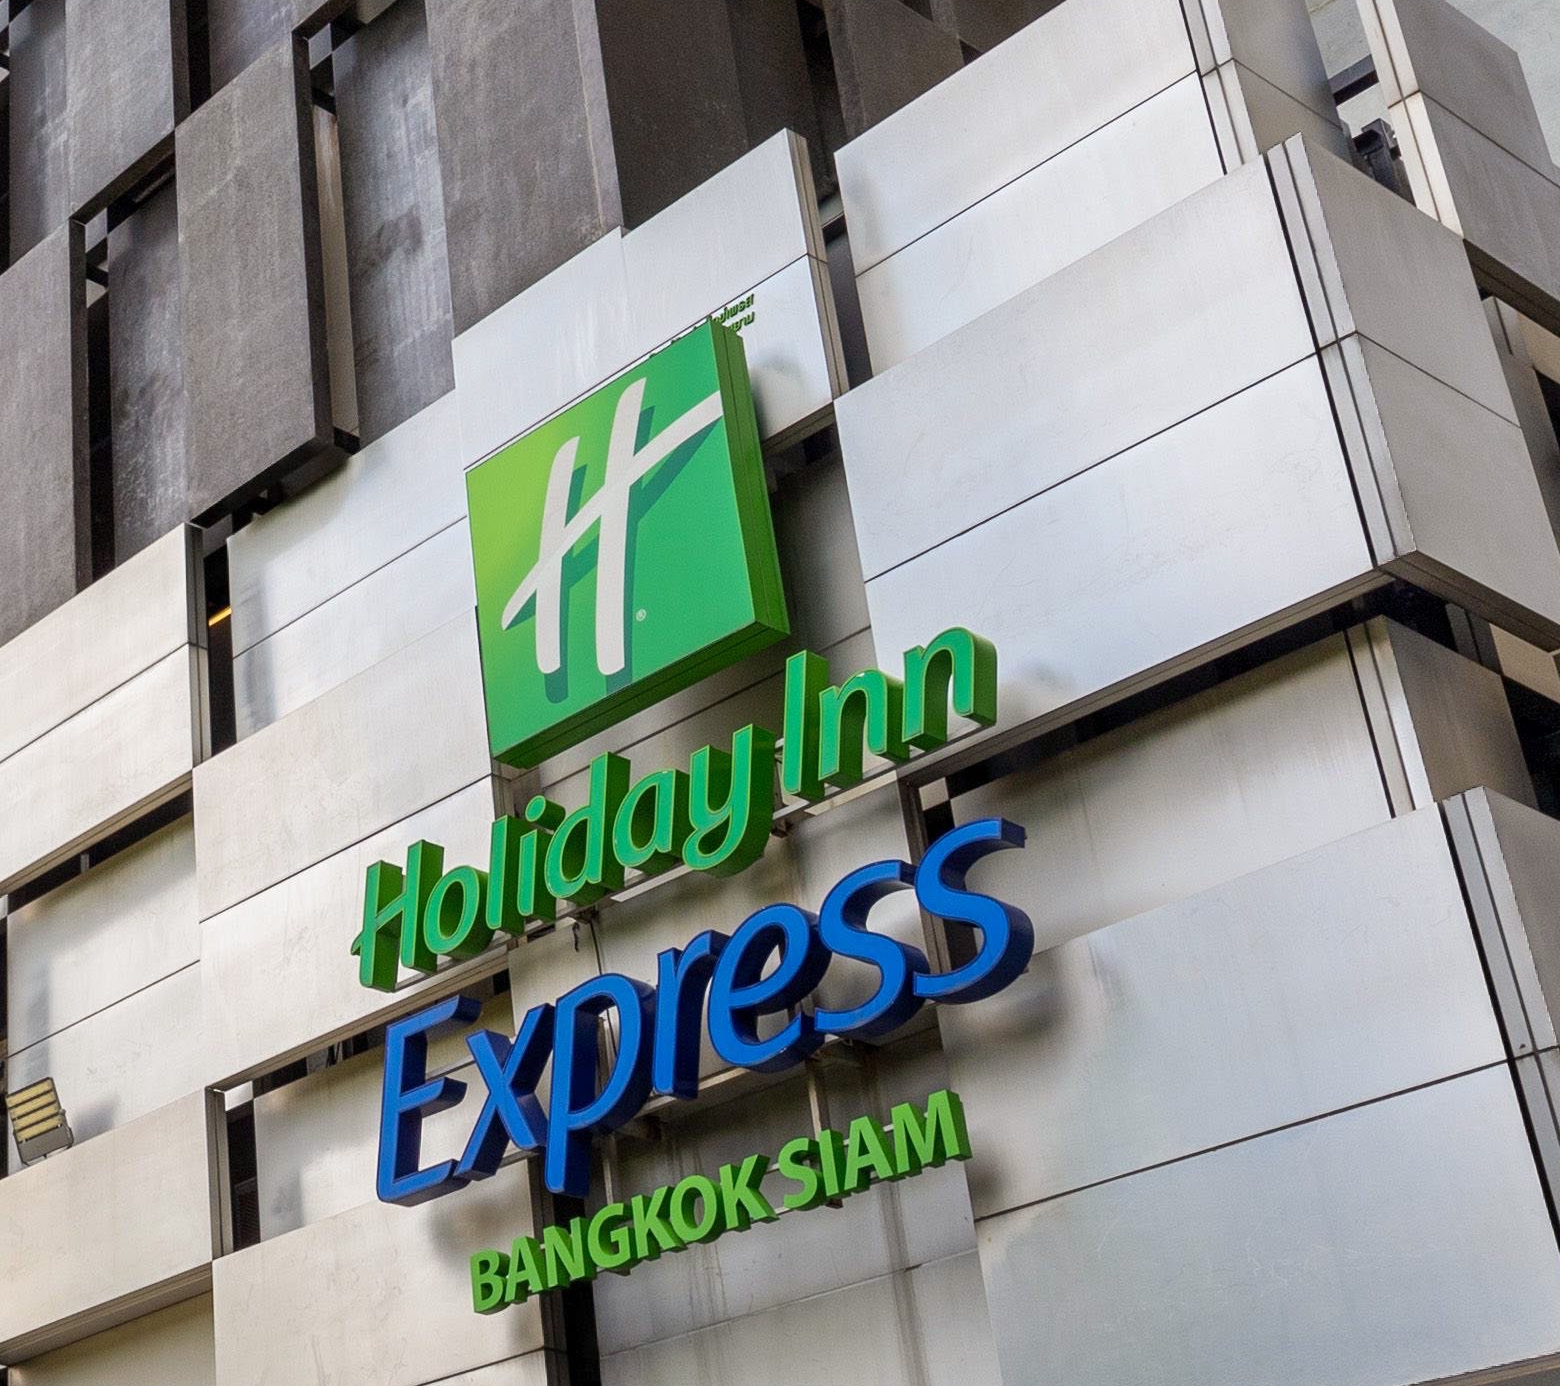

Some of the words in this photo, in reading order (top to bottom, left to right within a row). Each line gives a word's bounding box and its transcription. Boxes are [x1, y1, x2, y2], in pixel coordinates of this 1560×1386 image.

[353, 723, 776, 991] Holiday
[782, 626, 998, 802] Inn
[377, 816, 1035, 1205] Express
[470, 1153, 779, 1315] BANGKOK
[776, 1088, 973, 1211] SIAM
